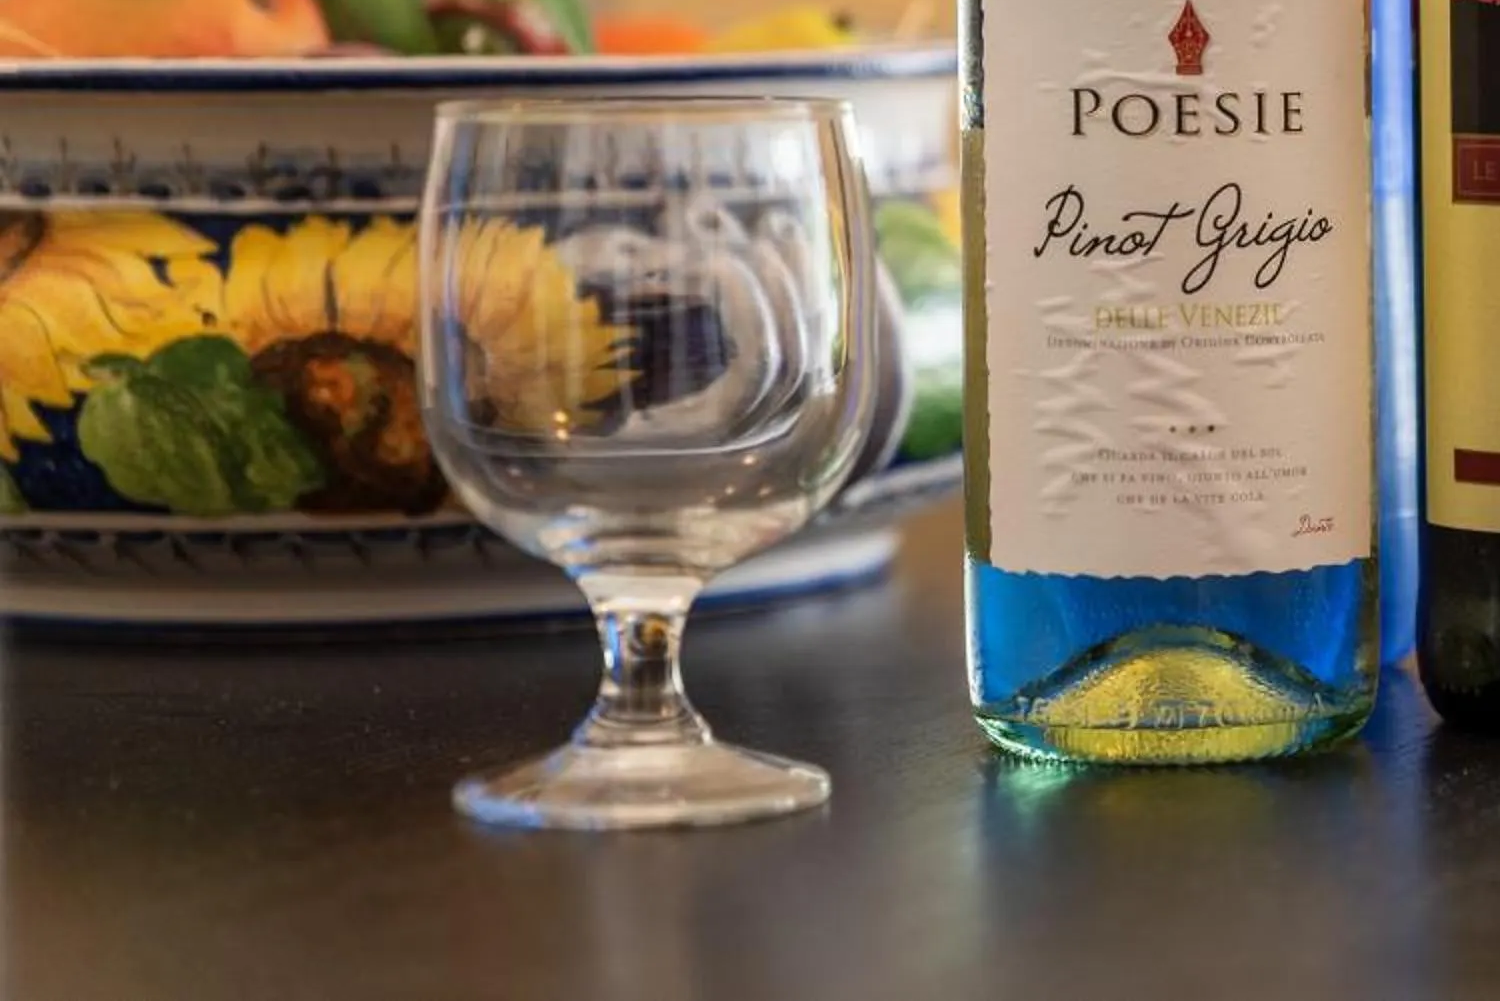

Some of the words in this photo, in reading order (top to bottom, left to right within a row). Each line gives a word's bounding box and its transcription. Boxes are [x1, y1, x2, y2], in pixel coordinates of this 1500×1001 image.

[1069, 87, 1304, 137] POESIE
[1473, 160, 1496, 181] LE
[1033, 184, 1196, 258] Pinot
[1181, 182, 1334, 295] Grigio
[1095, 304, 1169, 330] DELLE
